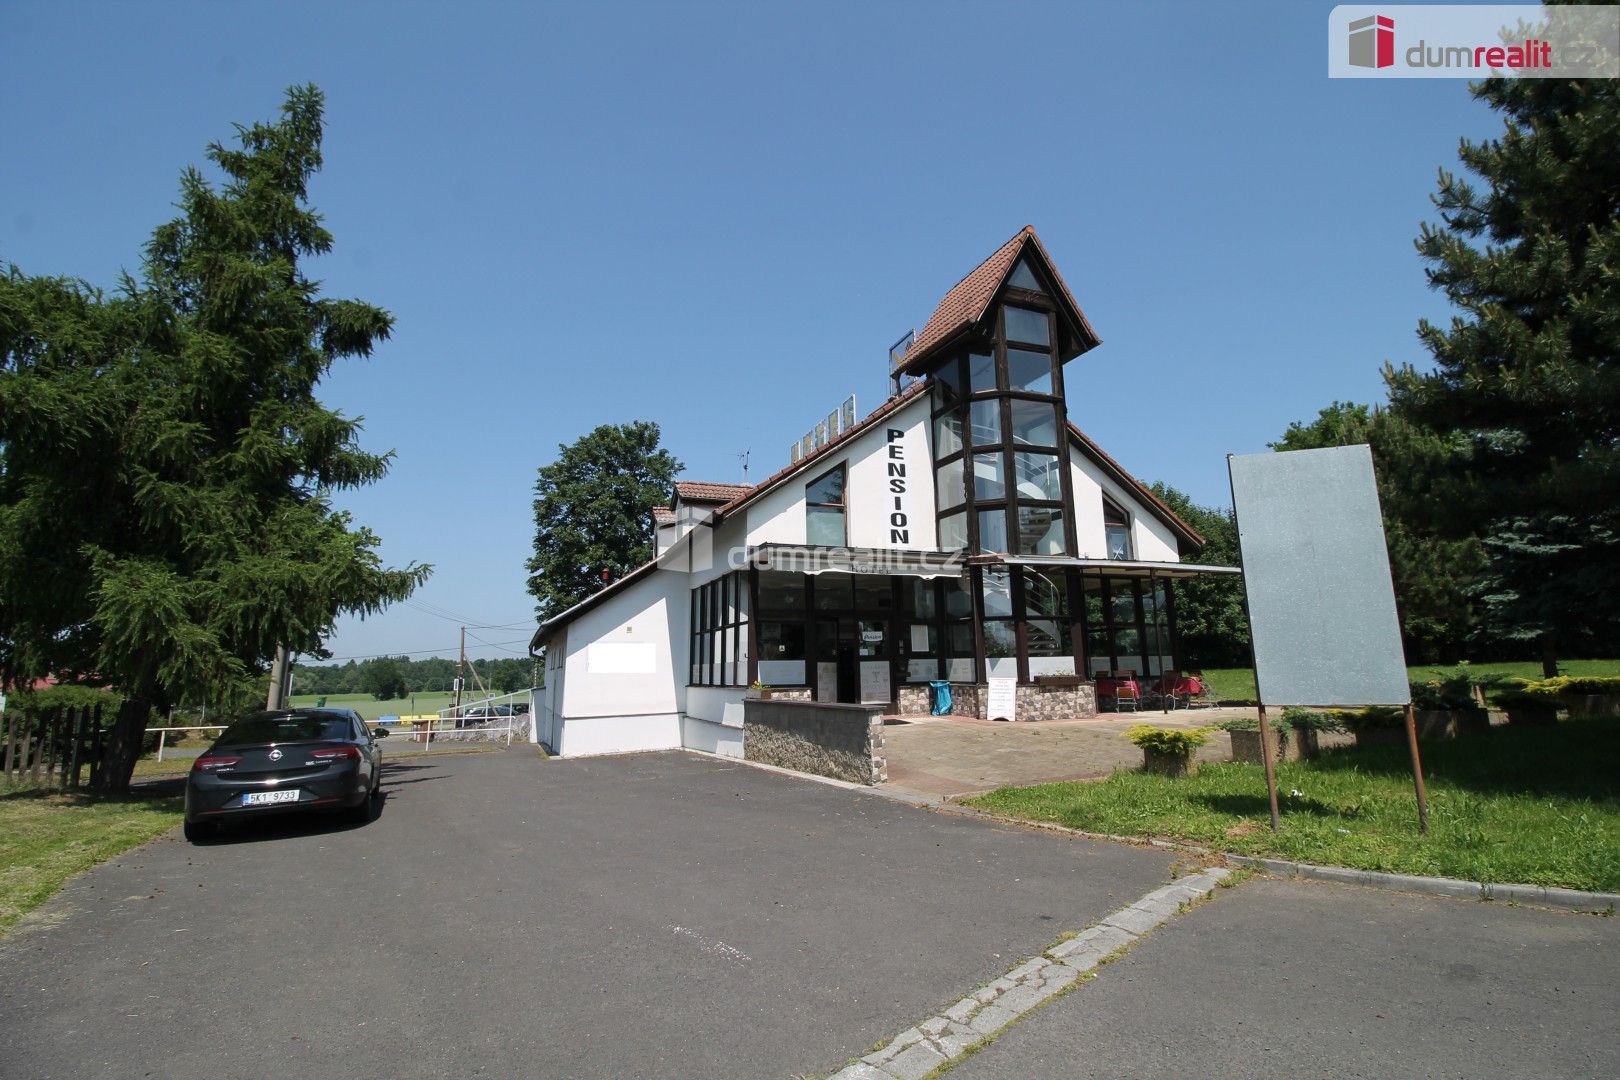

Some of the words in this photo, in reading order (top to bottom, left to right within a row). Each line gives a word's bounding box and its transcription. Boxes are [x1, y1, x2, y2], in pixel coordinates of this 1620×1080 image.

[887, 428, 909, 544] PENSION
[250, 793, 267, 802] 5K1
[273, 791, 296, 801] 9733
